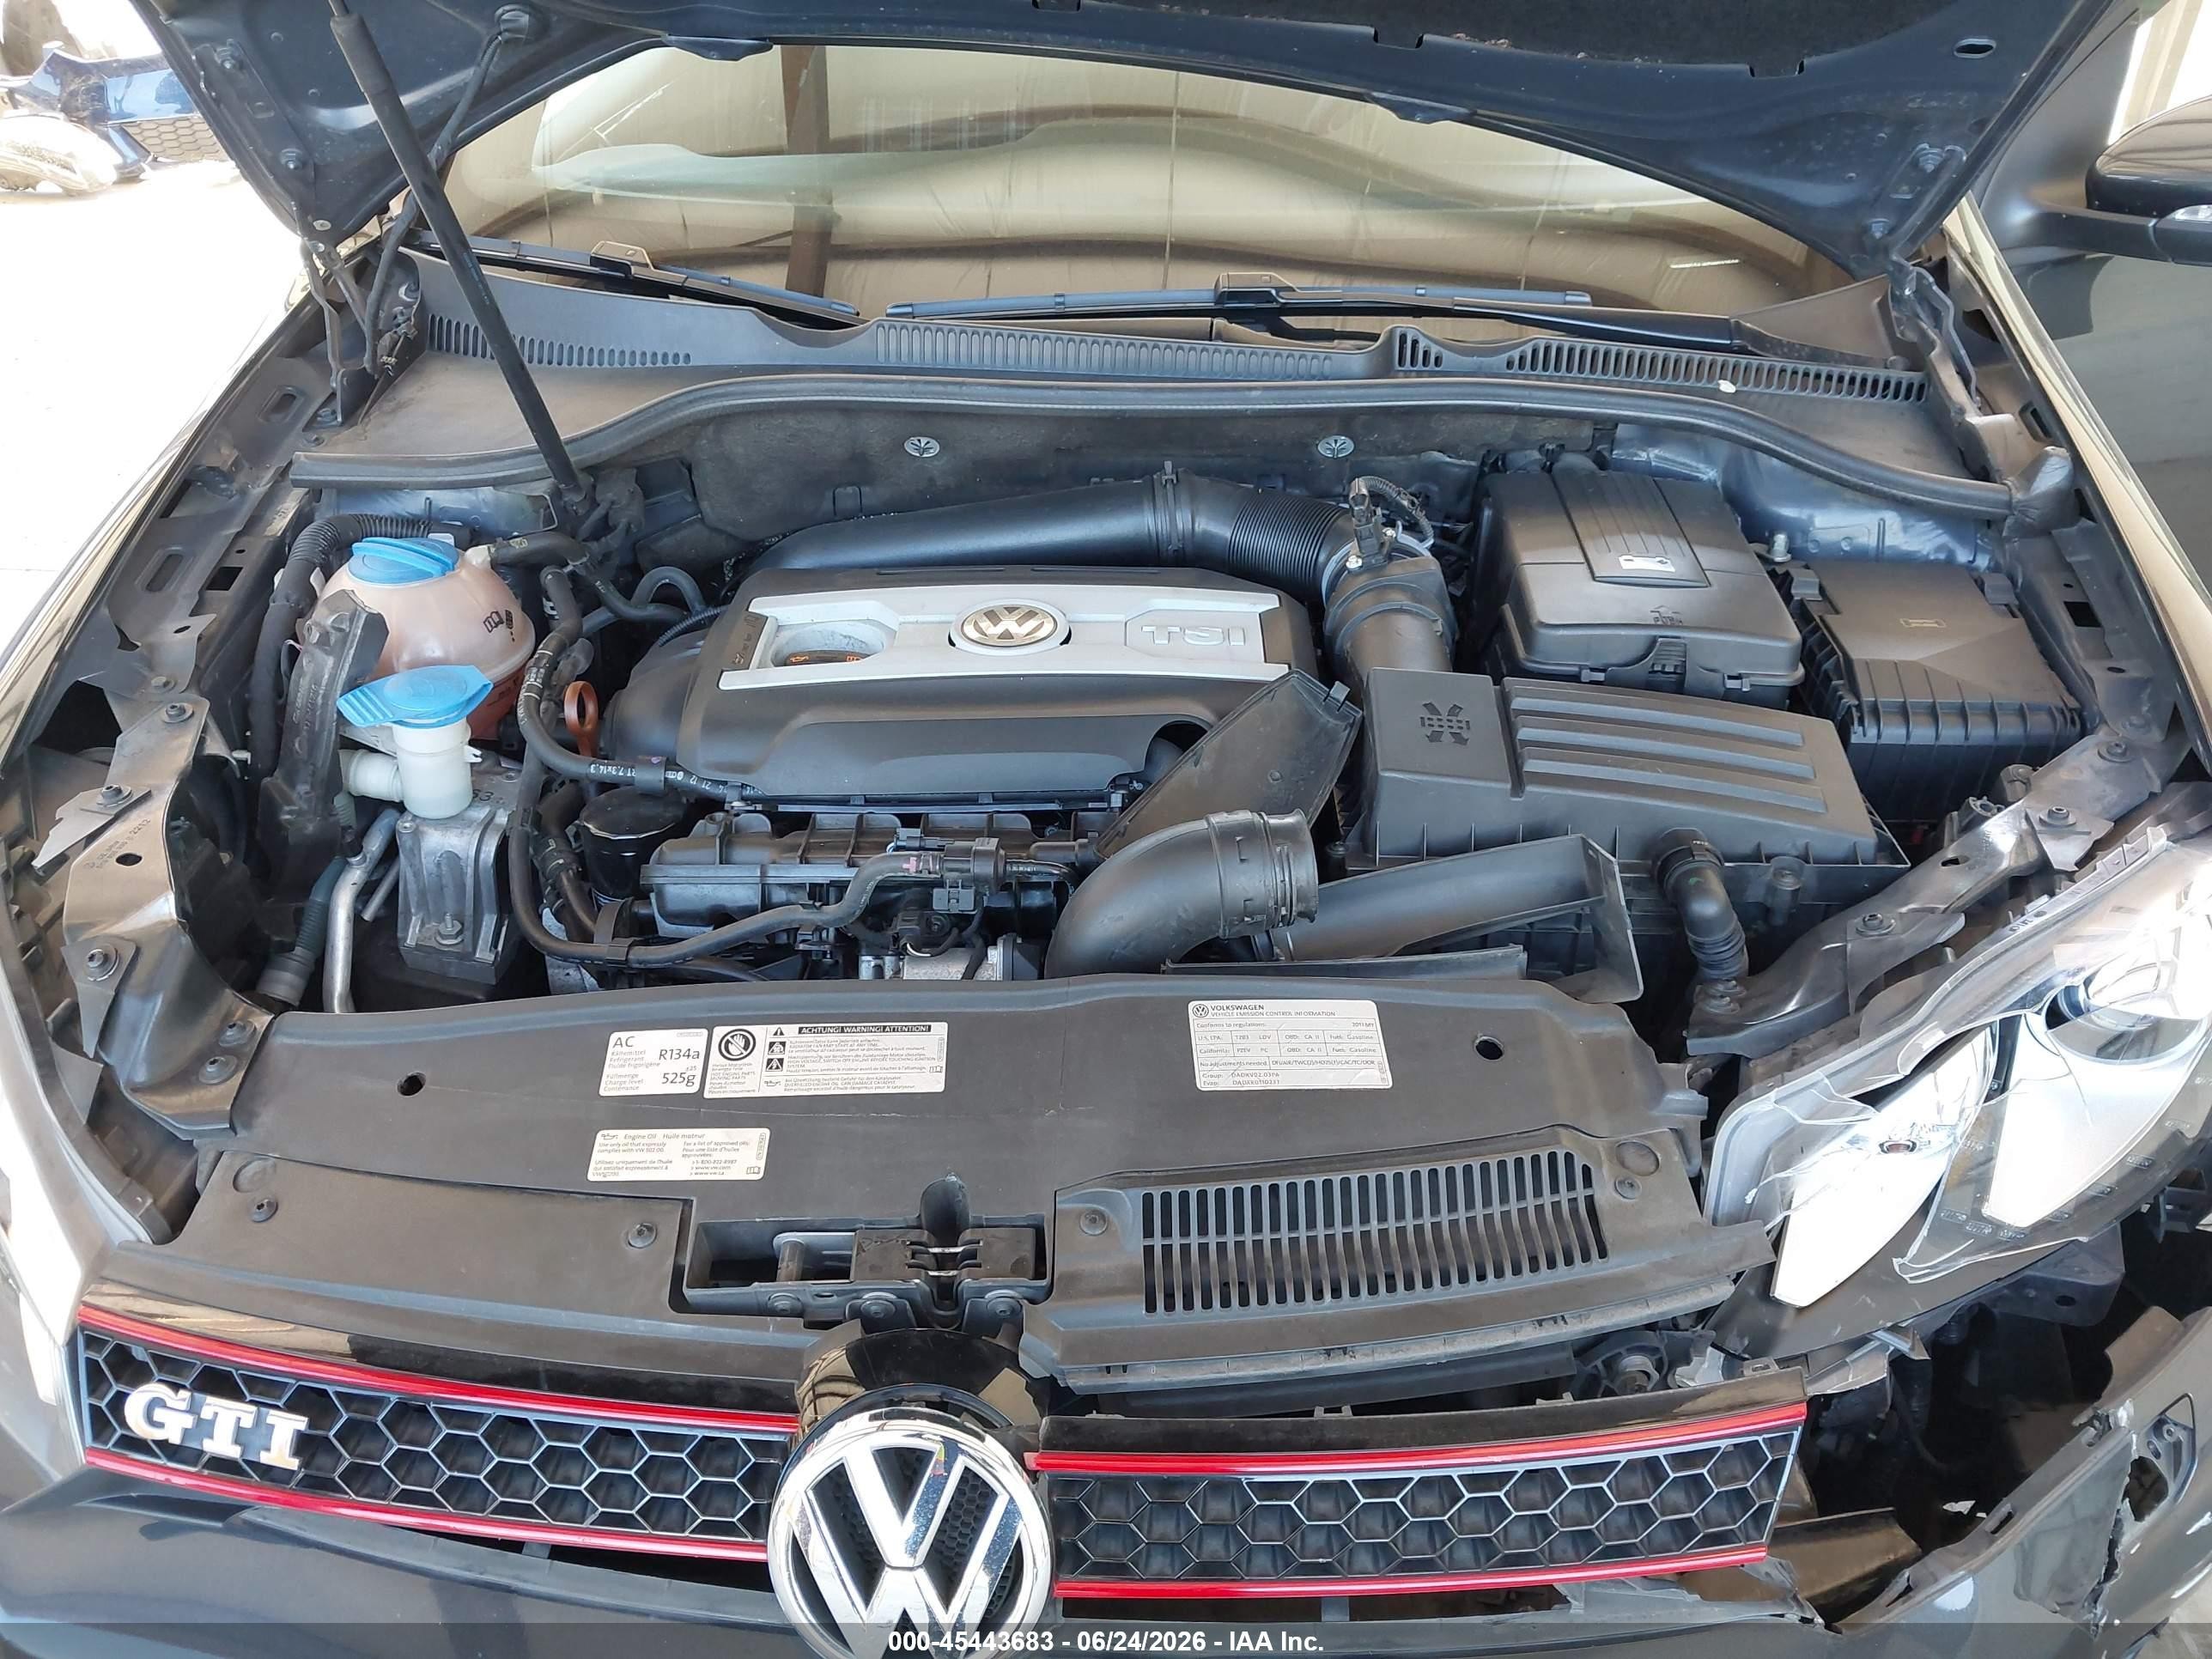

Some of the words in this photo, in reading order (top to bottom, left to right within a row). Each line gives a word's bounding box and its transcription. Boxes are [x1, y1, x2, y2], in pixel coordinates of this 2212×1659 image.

[1141, 624, 1245, 646] TSI
[884, 1024, 929, 1033] ATTENTION!
[612, 1036, 636, 1048] AC
[659, 1048, 701, 1060] R134a
[661, 1072, 696, 1087] 525g
[124, 1382, 309, 1471] GTI
